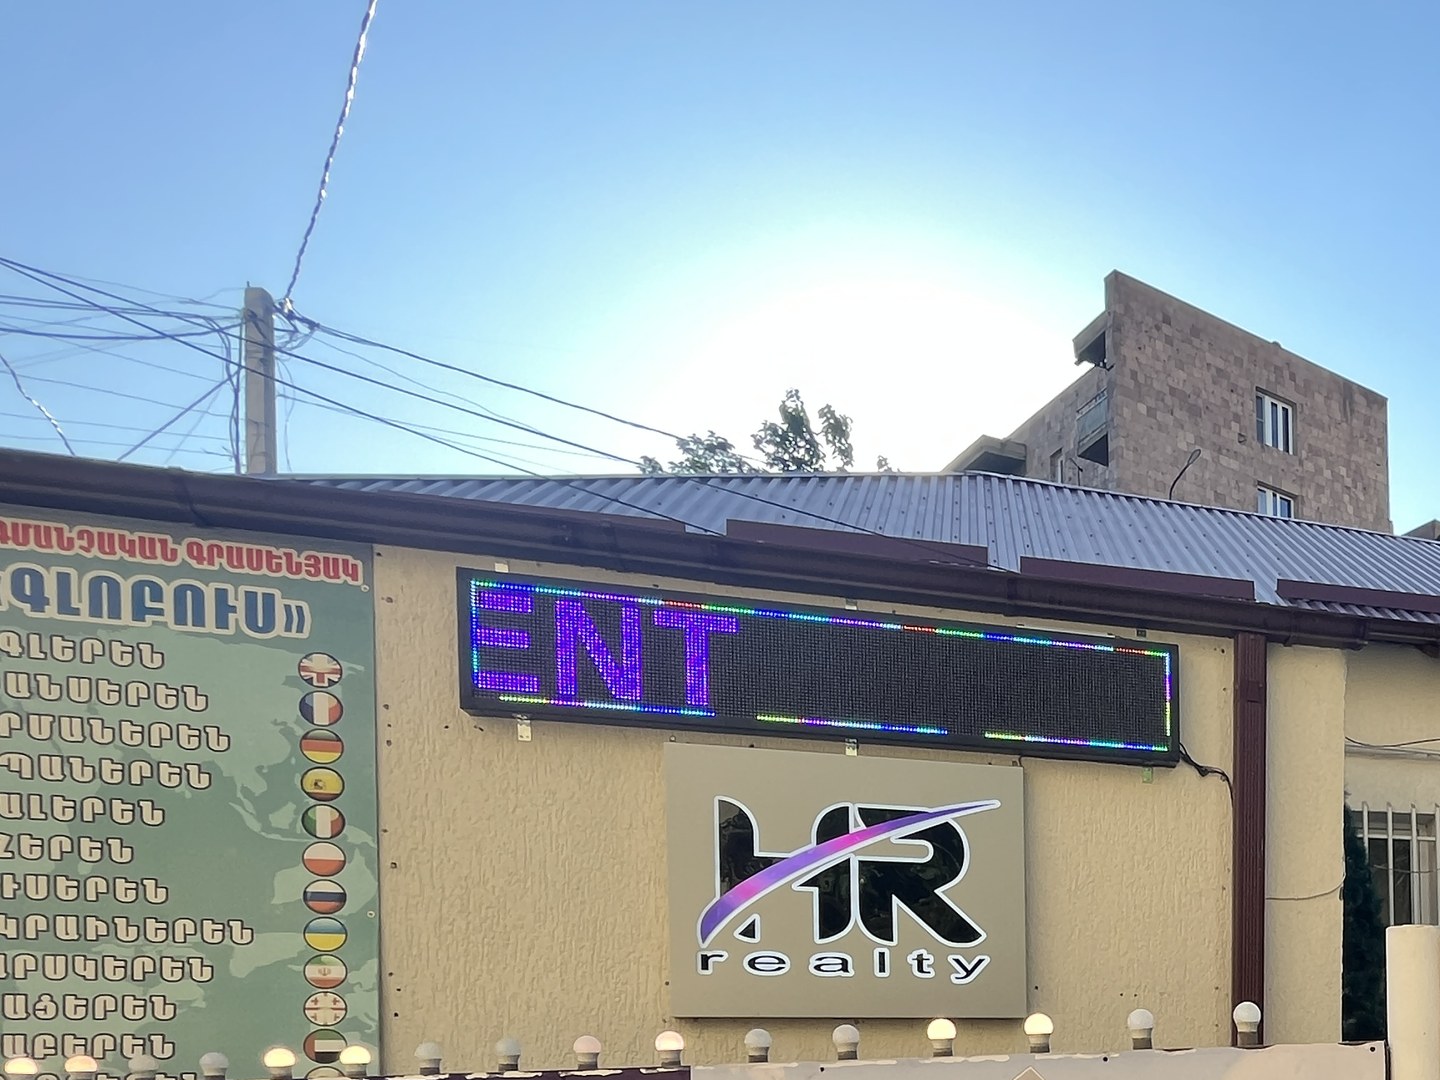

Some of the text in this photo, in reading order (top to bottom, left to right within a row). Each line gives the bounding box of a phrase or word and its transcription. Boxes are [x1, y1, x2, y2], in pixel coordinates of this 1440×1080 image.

[186, 540, 360, 583] ԳՐԱՍԵՆՅԱԿ
[471, 588, 739, 707] ENT
[4, 671, 209, 713] ԱՆՍԵՐԵՆ
[699, 796, 1000, 948] HR
[699, 949, 993, 985] realty
